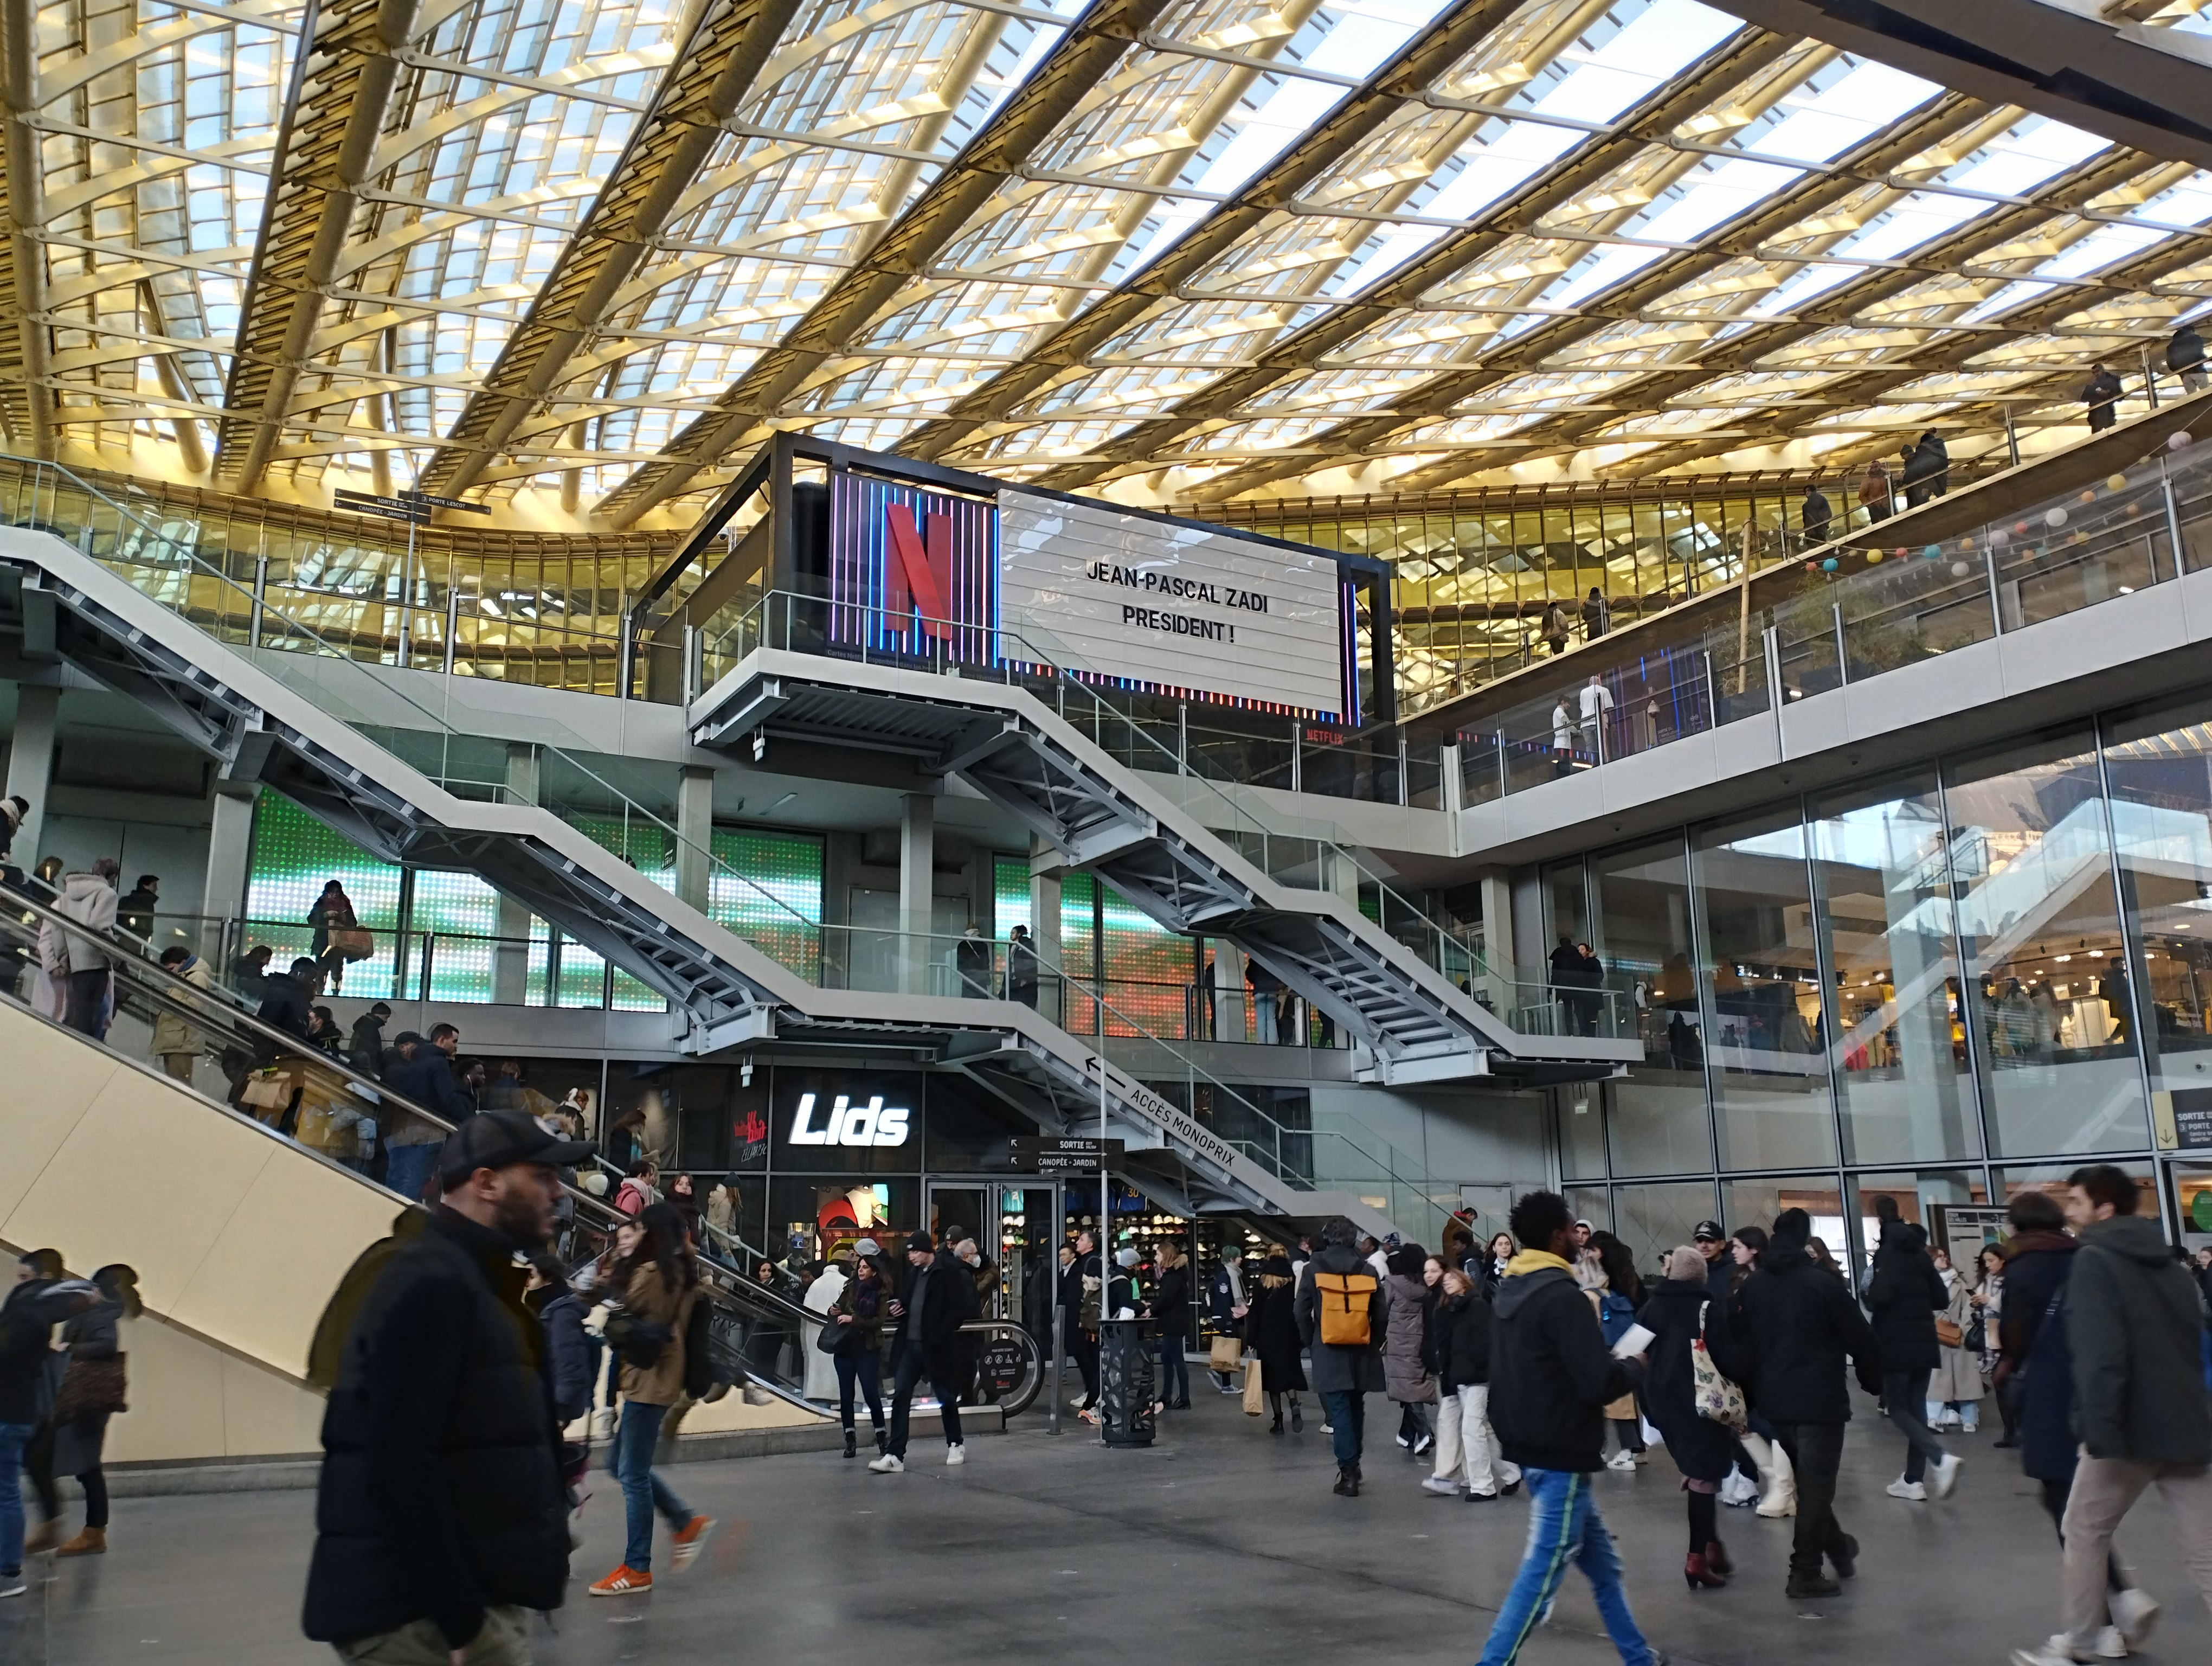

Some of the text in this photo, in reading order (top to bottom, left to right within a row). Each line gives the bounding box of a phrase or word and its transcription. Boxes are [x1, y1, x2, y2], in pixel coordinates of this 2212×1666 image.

[377, 498, 398, 507] SORTIE
[447, 501, 466, 509] LESCOT
[387, 510, 408, 519] JARDIN
[1087, 562, 1268, 614] JEAN-PASCAL ZADI
[1123, 605, 1225, 642] PRESIDENT
[827, 649, 846, 658] Cartes
[847, 652, 864, 661] Netfli
[1002, 678, 1018, 686] Foum
[1028, 682, 1045, 691] Halles
[1307, 728, 1343, 746] NETFLIX
[789, 1092, 909, 1146] Lids
[2177, 1112, 2206, 1122] SORTIE
[1130, 1089, 1236, 1167] ACCÈS MONOPRIX
[2188, 1123, 2211, 1131] PORTE
[1059, 1140, 1084, 1150] SORTIE
[1038, 1157, 1068, 1167] CANOPÉE
[1073, 1158, 1097, 1167] JARDIN
[1128, 1188, 1139, 1198] 30
